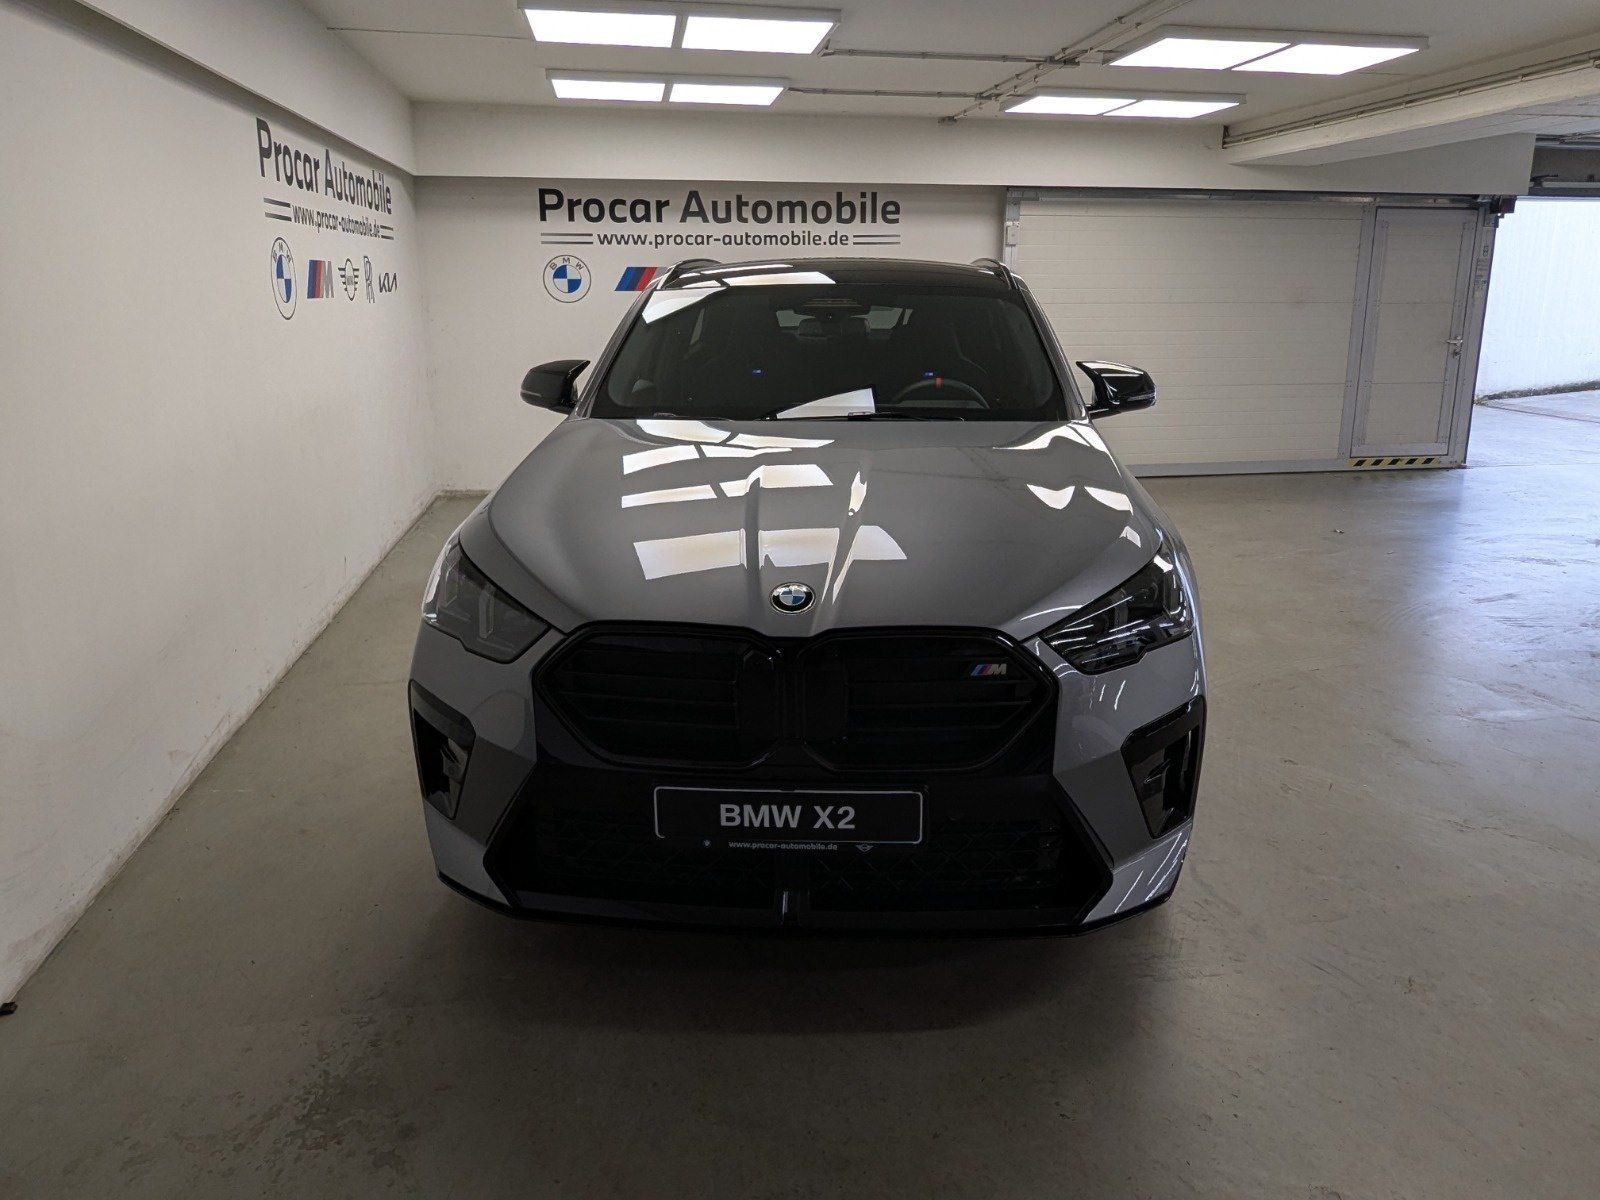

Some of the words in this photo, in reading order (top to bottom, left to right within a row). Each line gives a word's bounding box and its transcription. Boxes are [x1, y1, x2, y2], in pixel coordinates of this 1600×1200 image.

[256, 117, 320, 194] Procar
[325, 148, 392, 215] Automobile
[538, 187, 670, 223] Procar
[679, 190, 901, 225] Automobile
[292, 204, 381, 239] www.procar-automobile.de
[597, 231, 849, 249] www.procar-automobile.de
[549, 257, 583, 271] BMW
[720, 803, 802, 828] BMW
[812, 805, 856, 829] X2
[728, 841, 838, 850] www.procar-automobile.de
